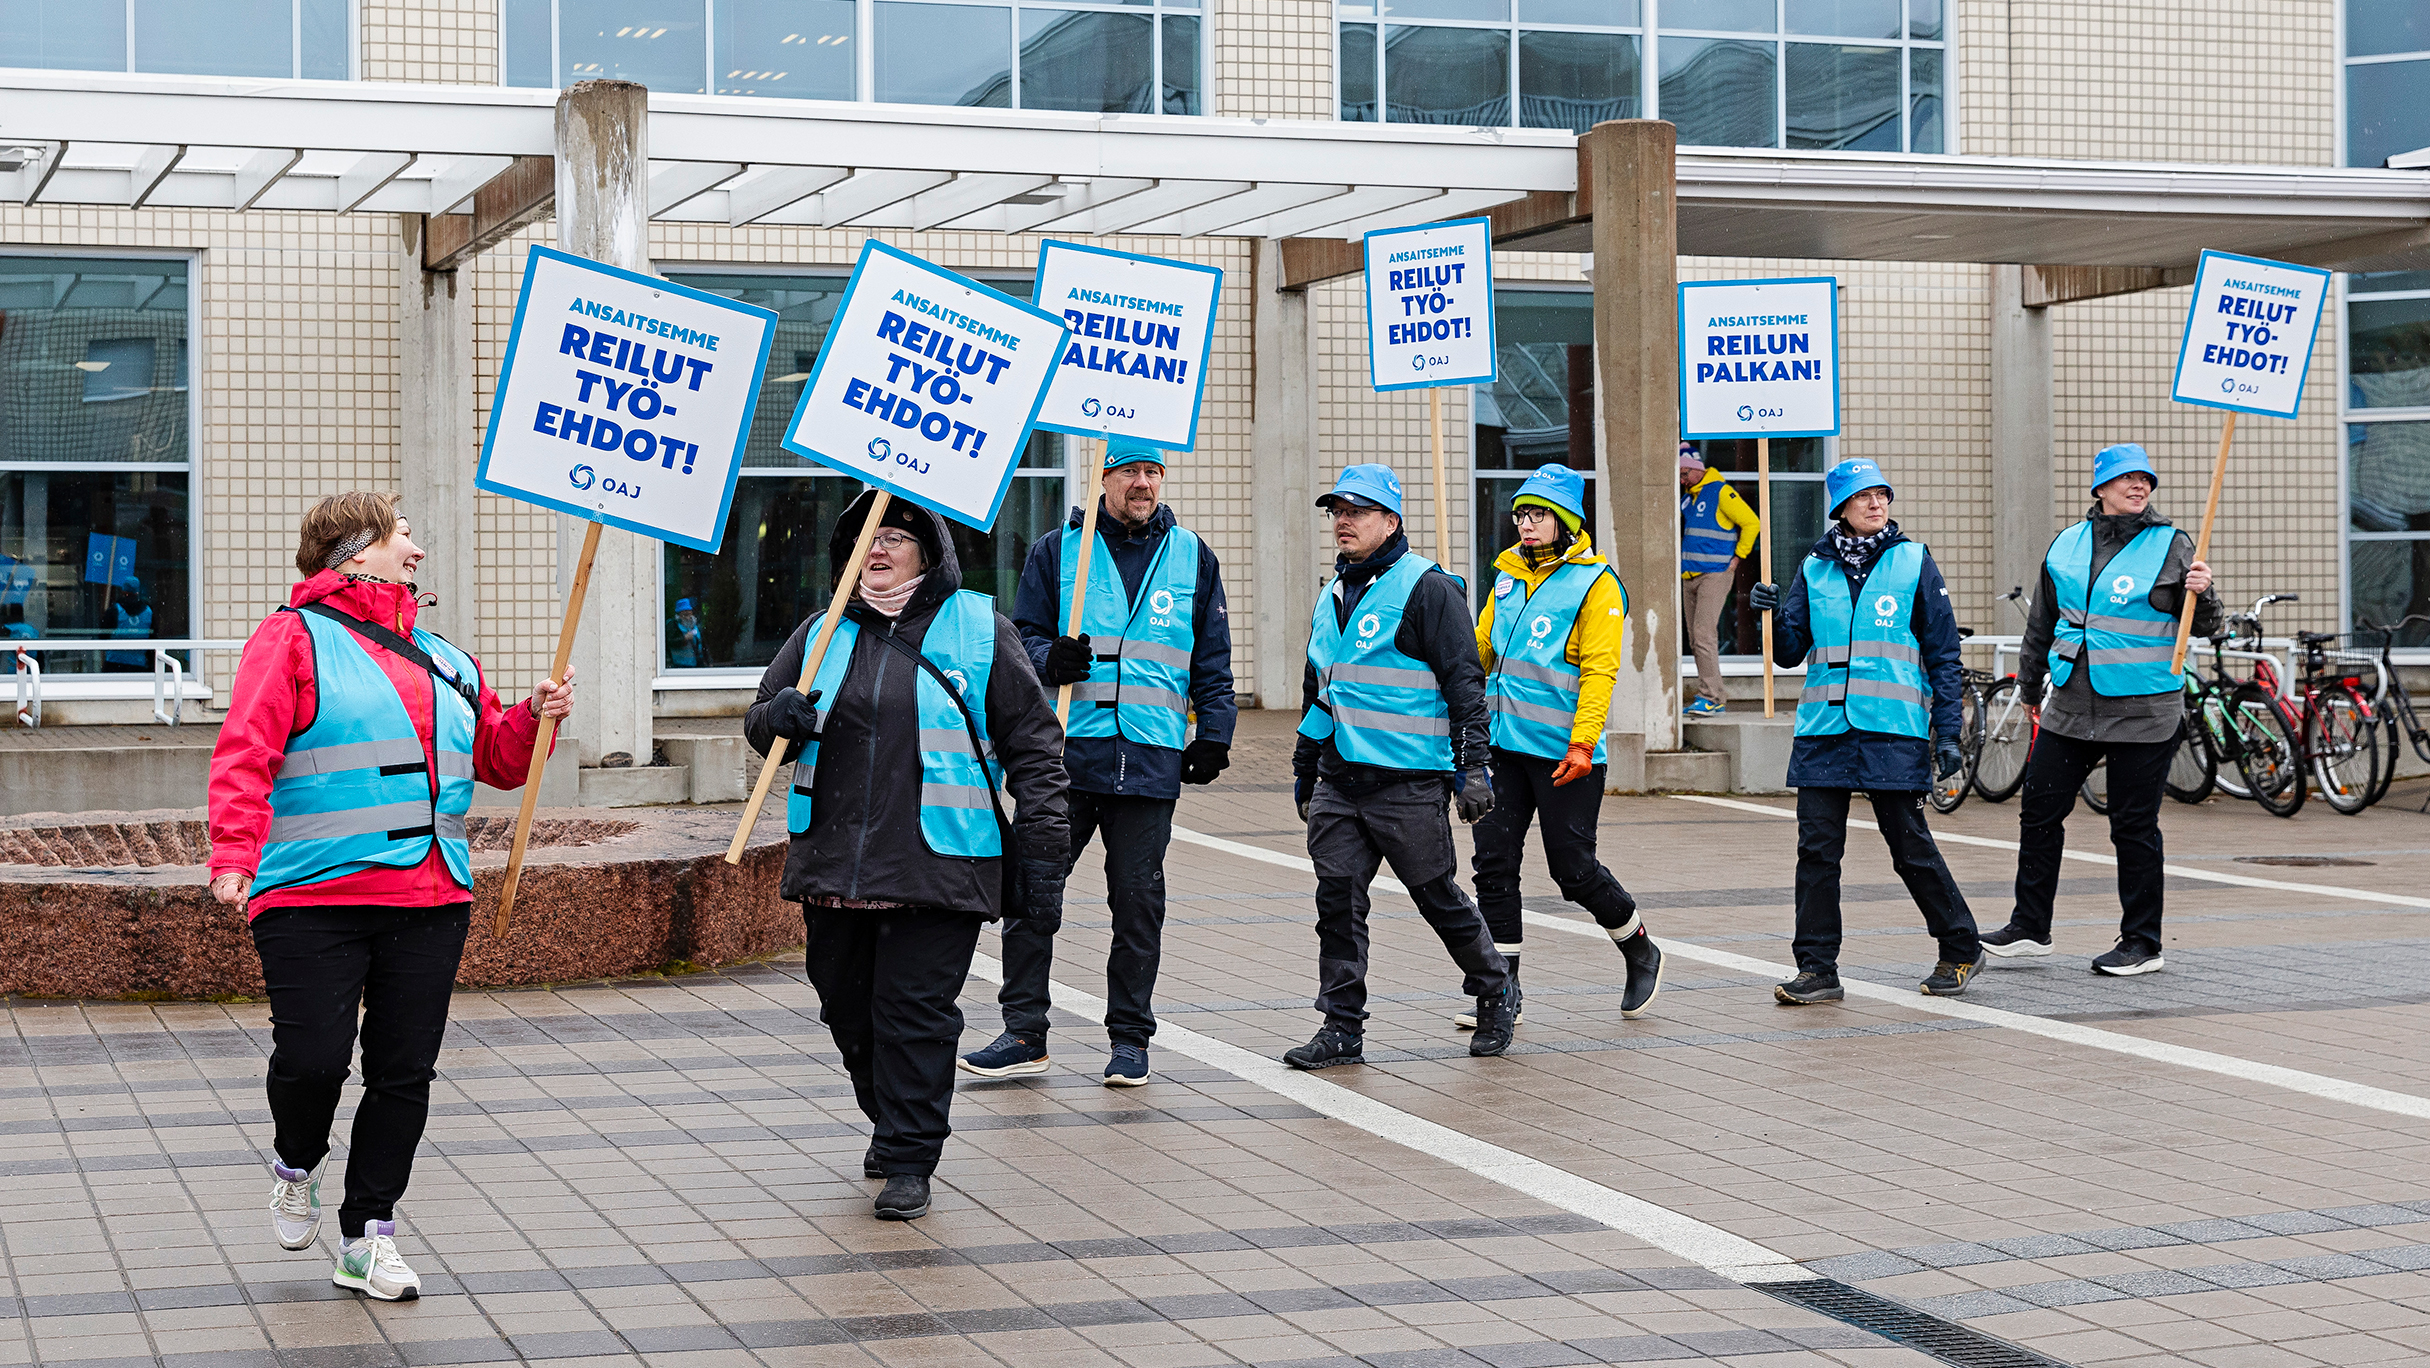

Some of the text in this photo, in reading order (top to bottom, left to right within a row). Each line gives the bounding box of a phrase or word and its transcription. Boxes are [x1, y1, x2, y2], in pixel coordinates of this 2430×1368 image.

[1389, 245, 1465, 263] ANSAITSEMME
[1390, 263, 1465, 291] REILUT
[2223, 278, 2301, 299] ANSAITSEMME
[1067, 288, 1183, 317] ANSAITSEMME
[1401, 287, 1454, 316] TYÖ-
[2218, 295, 2297, 324] REILUT
[569, 297, 720, 351] ANSAITSEMME
[891, 289, 1020, 352] ANSAITSEMME
[1064, 309, 1180, 350] REILUN
[1389, 317, 1471, 345] EHDOT!
[1708, 314, 1808, 327] ANSAITSEMME
[1708, 333, 1809, 356] REILUN
[2226, 321, 2278, 346] TYÖ-
[559, 323, 713, 391] REILUT
[877, 310, 1011, 385] REILUT
[2203, 344, 2288, 374] EHDOT!
[1061, 343, 1188, 384] ALKAN!
[1429, 356, 1449, 366] OAJ
[1697, 360, 1821, 383] PALKAN!
[886, 353, 973, 405] TYÖ-
[2238, 384, 2259, 394] OAJ
[576, 369, 677, 420] TYÖ-
[842, 377, 987, 458] EHDOT!
[1107, 405, 1134, 420] OAJ
[1758, 408, 1783, 418] OAJ
[533, 401, 699, 474] EHDOT!
[896, 453, 930, 475] OAJ
[603, 478, 641, 499] OAJ
[1541, 472, 1555, 481] OAJ
[2110, 595, 2128, 605] OAJ
[1150, 617, 1170, 627] OAJ
[1875, 618, 1893, 628] OAJ
[1355, 639, 1373, 650] OAJ
[1526, 639, 1544, 650] OAJ
